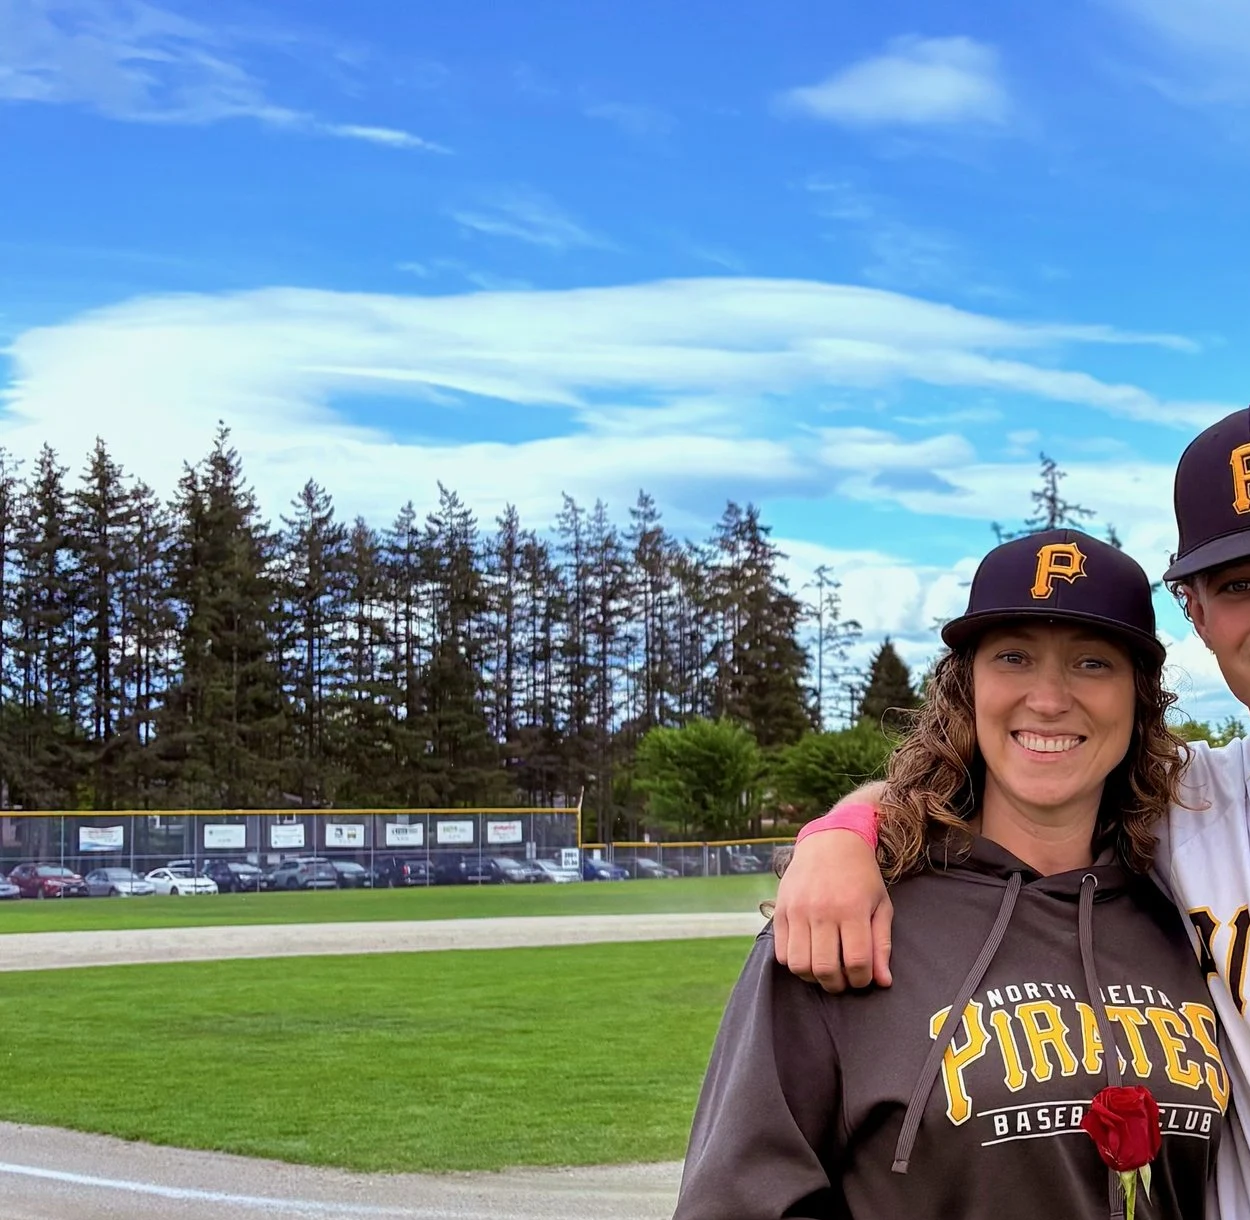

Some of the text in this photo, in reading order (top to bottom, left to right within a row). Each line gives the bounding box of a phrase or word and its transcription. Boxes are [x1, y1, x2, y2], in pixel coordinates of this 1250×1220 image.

[1030, 542, 1087, 600] P
[986, 982, 1174, 1009] NORTH ELTA
[929, 996, 1230, 1127] PIRATES
[993, 1105, 1083, 1137] BASEB
